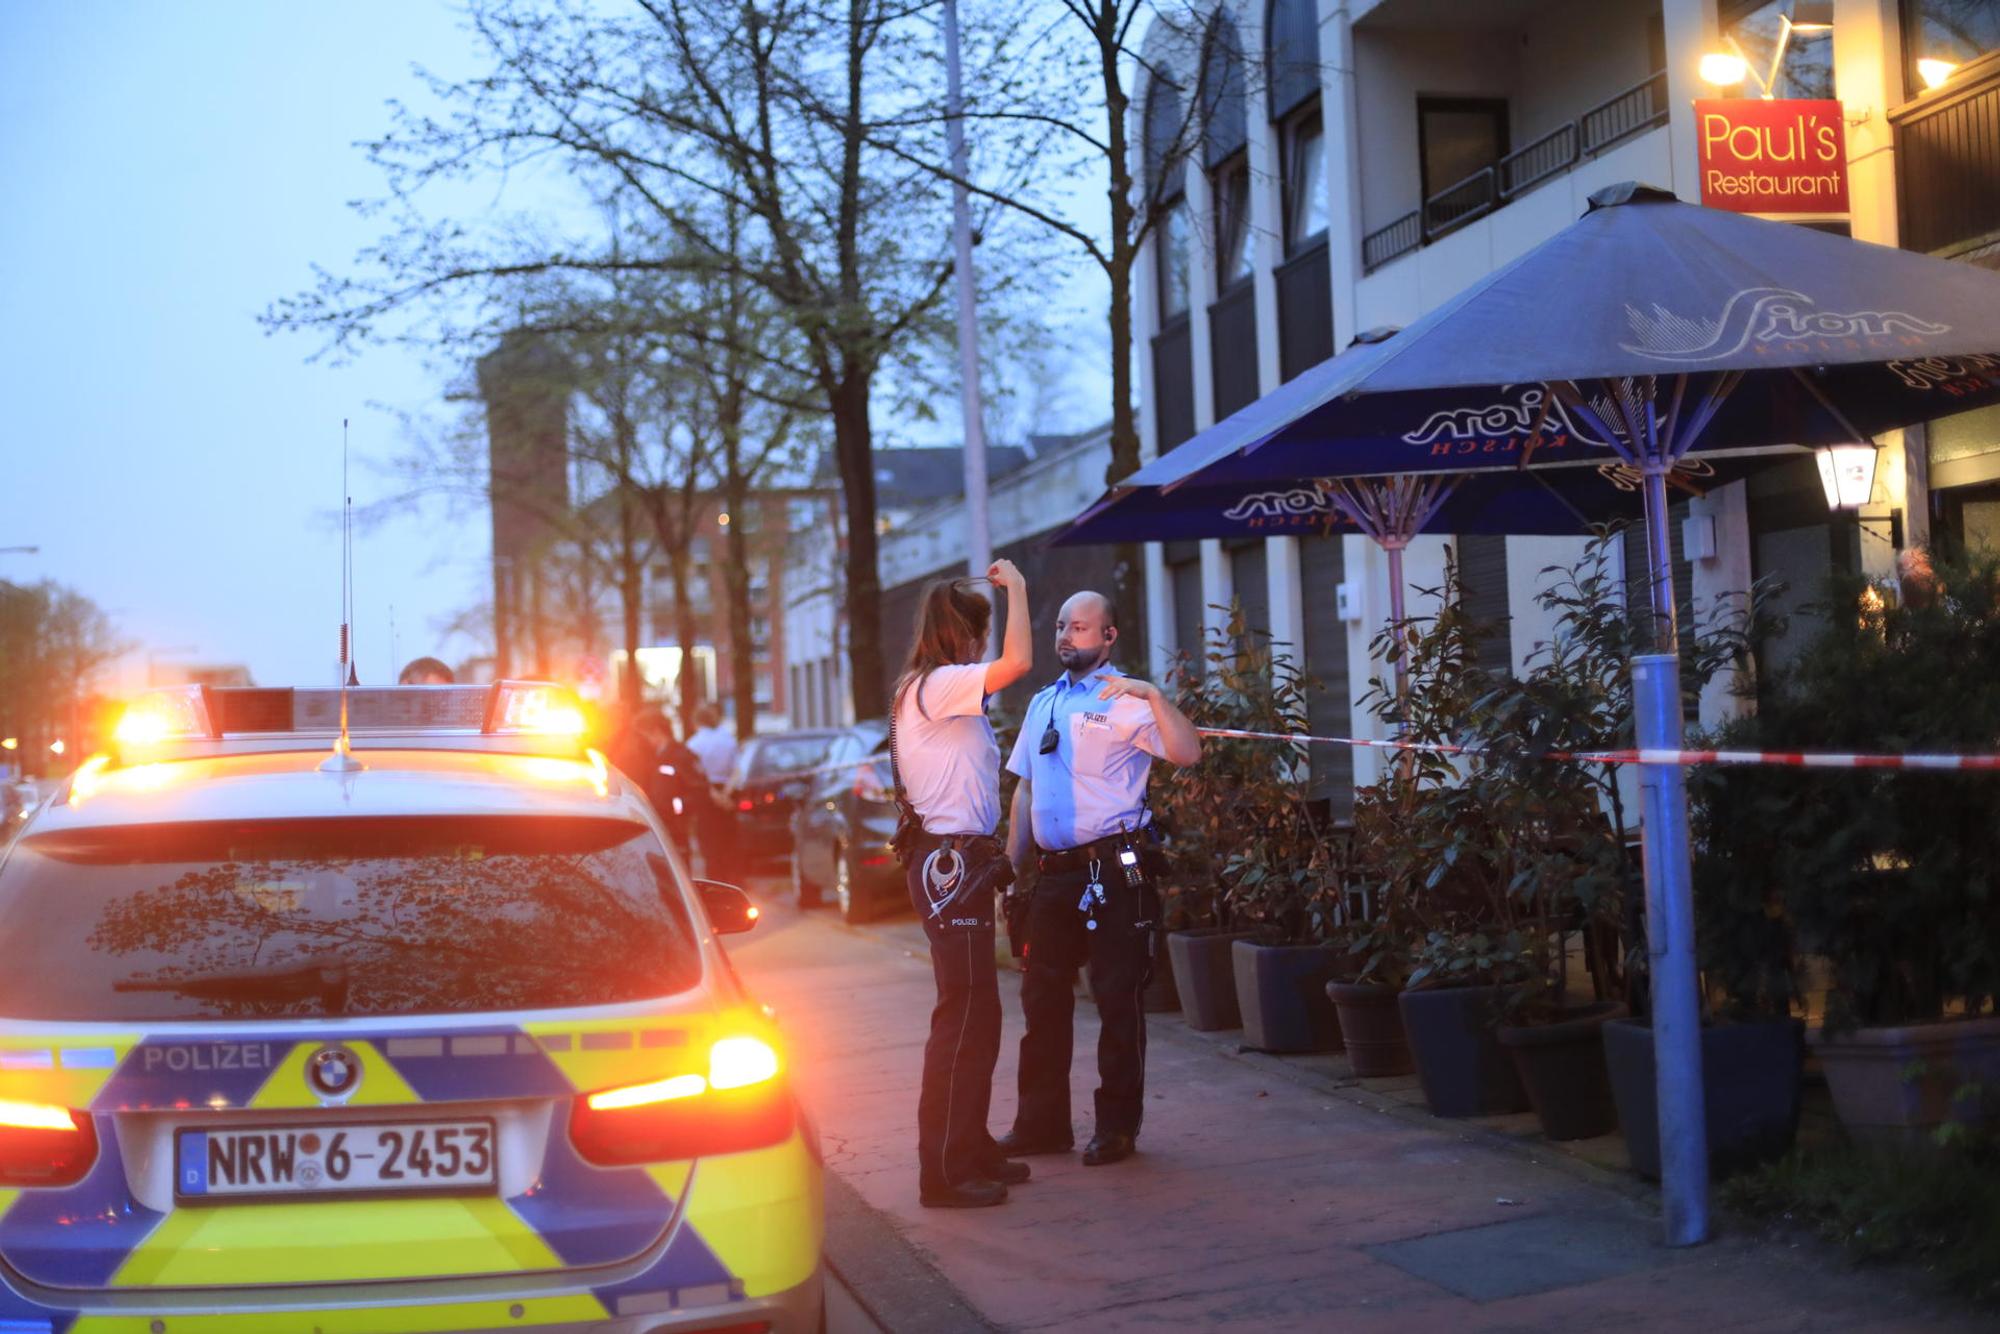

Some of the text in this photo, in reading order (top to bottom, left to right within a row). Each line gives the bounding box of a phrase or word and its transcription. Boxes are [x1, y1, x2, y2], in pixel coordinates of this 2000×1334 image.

[1704, 113, 1838, 161] Paul's
[1707, 169, 1841, 195] Restaurant
[1083, 711, 1108, 723] POLIZEI
[951, 918, 978, 926] POLIZEI
[144, 1042, 271, 1072] POLIZEI
[207, 1127, 490, 1186] NRW 6-2453
[186, 1169, 199, 1185] D
